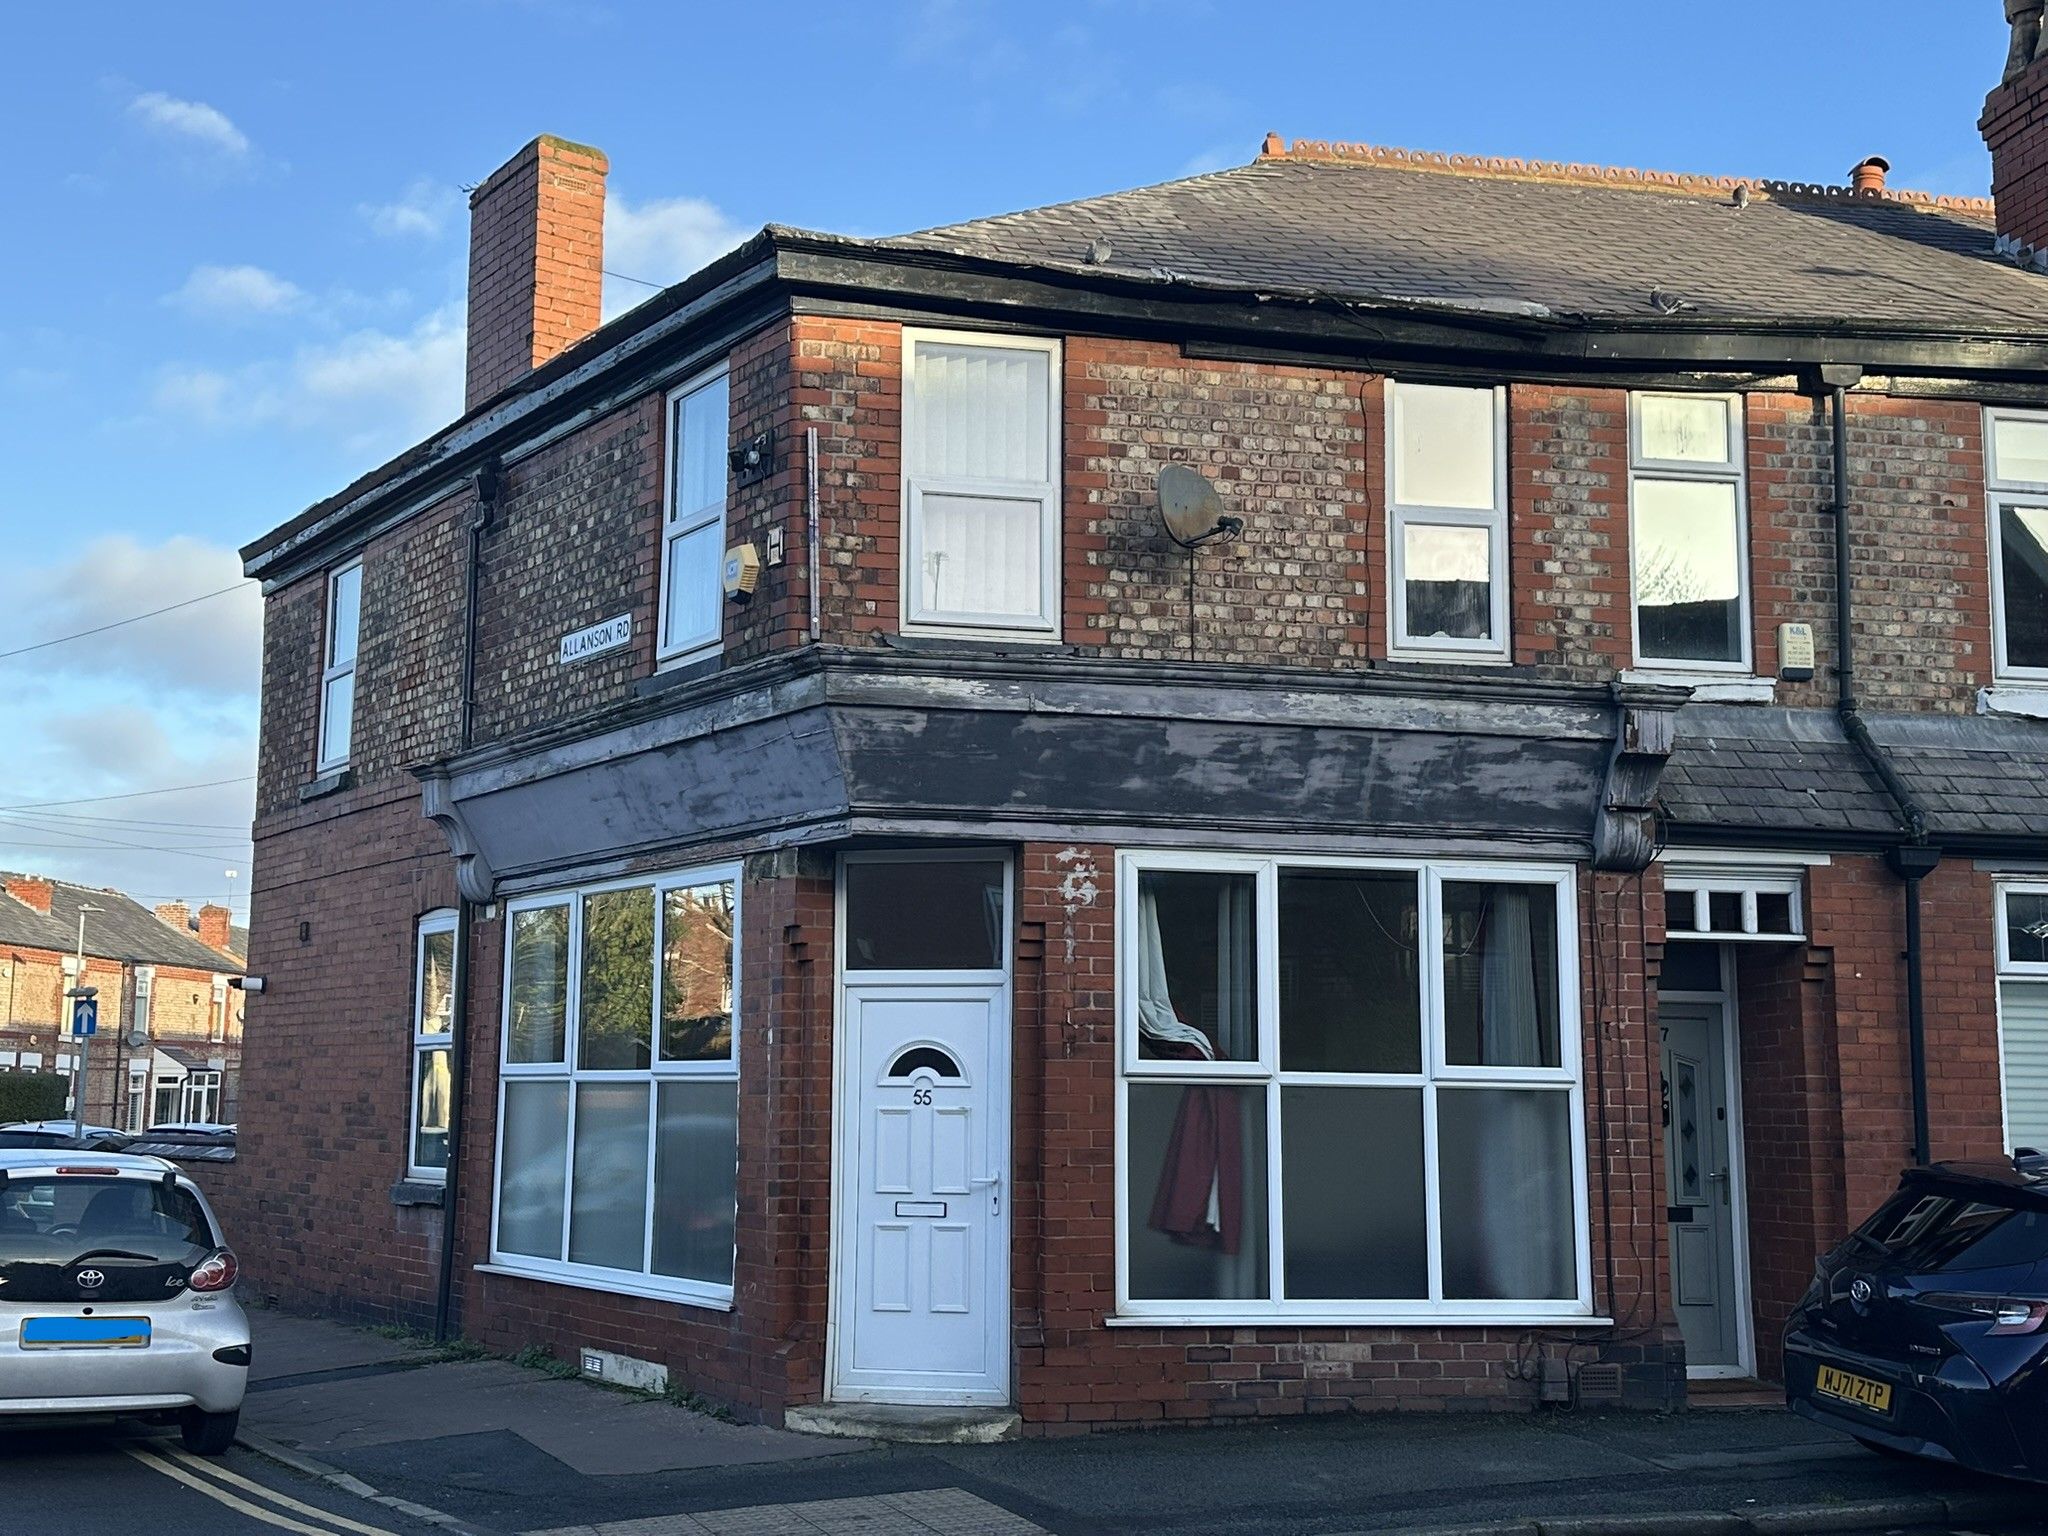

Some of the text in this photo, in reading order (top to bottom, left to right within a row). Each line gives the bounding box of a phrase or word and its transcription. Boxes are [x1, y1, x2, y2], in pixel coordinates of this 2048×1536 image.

[562, 620, 629, 659] ALLANSON RD
[913, 1089, 932, 1106] 55
[165, 1275, 184, 1287] Ice
[1824, 1368, 1884, 1404] MJ71 ZTP
